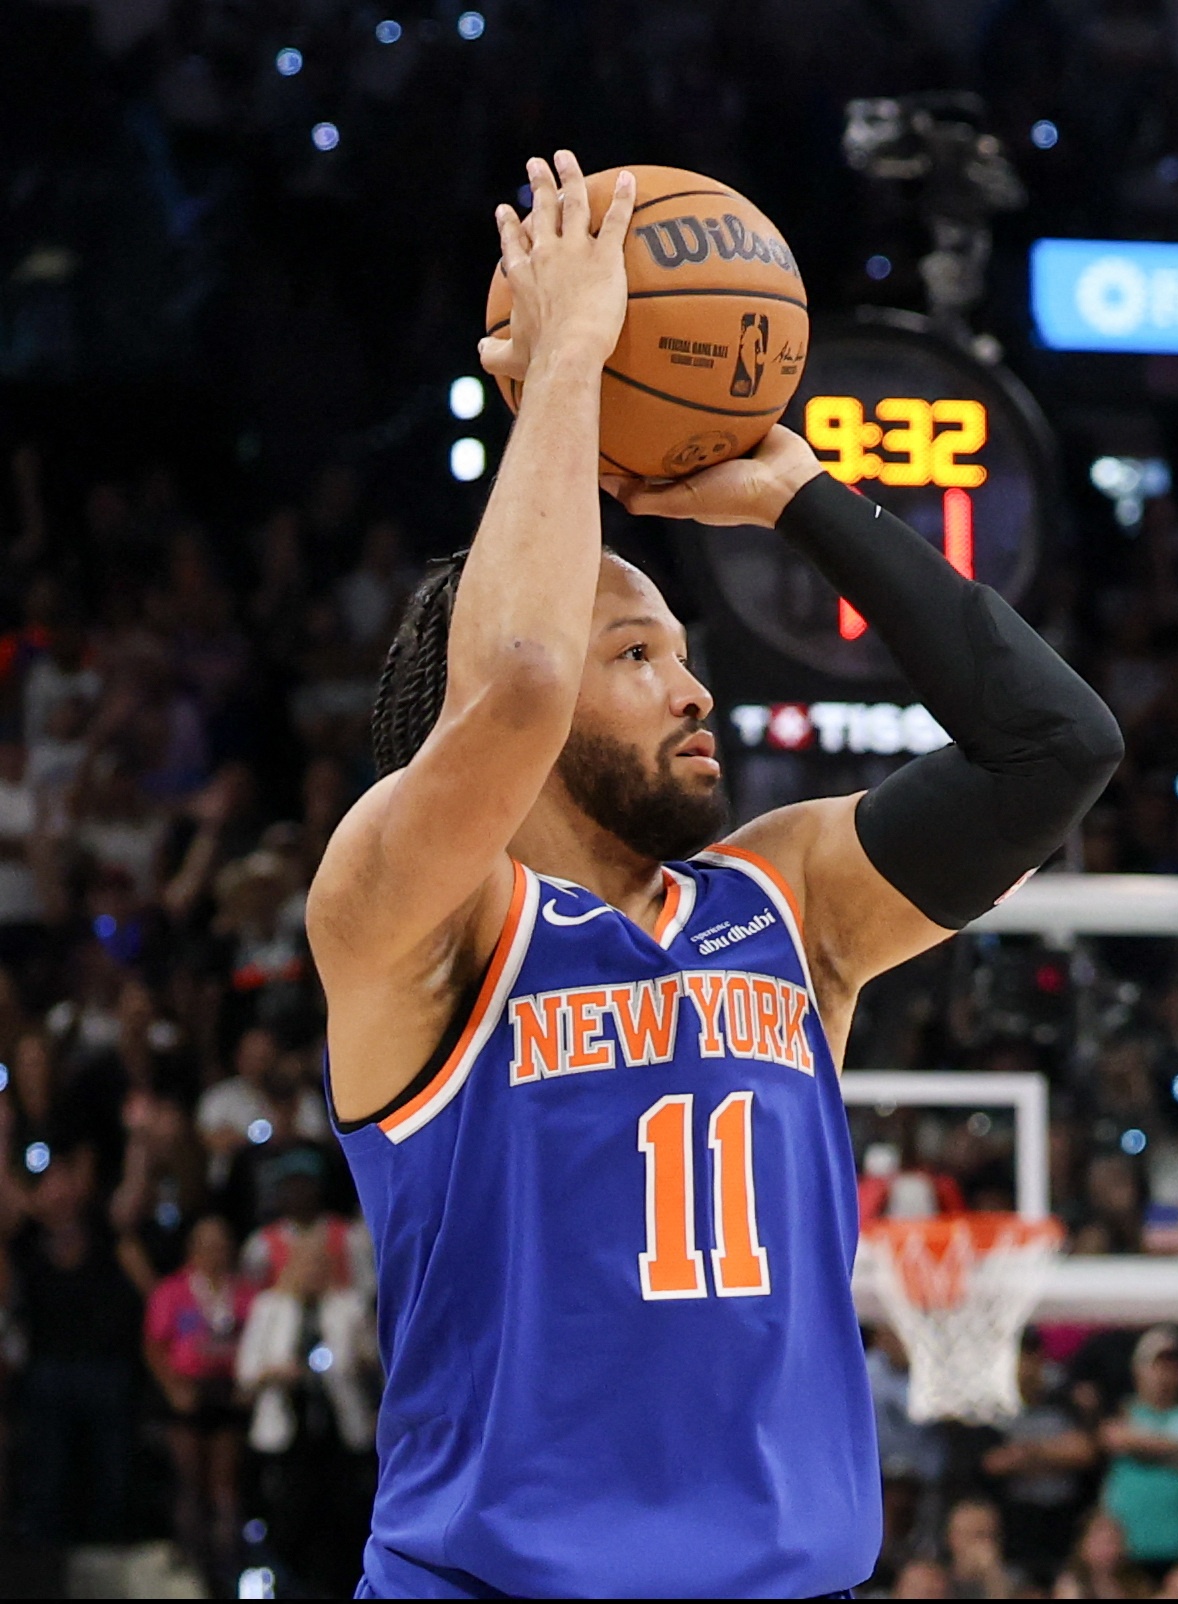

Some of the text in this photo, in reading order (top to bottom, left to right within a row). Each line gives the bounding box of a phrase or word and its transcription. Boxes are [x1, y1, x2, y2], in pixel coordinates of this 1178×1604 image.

[805, 395, 988, 488] 9:32
[699, 907, 777, 956] abu dhabi
[508, 970, 814, 1087] NEW YORK
[637, 1091, 771, 1300] 11
